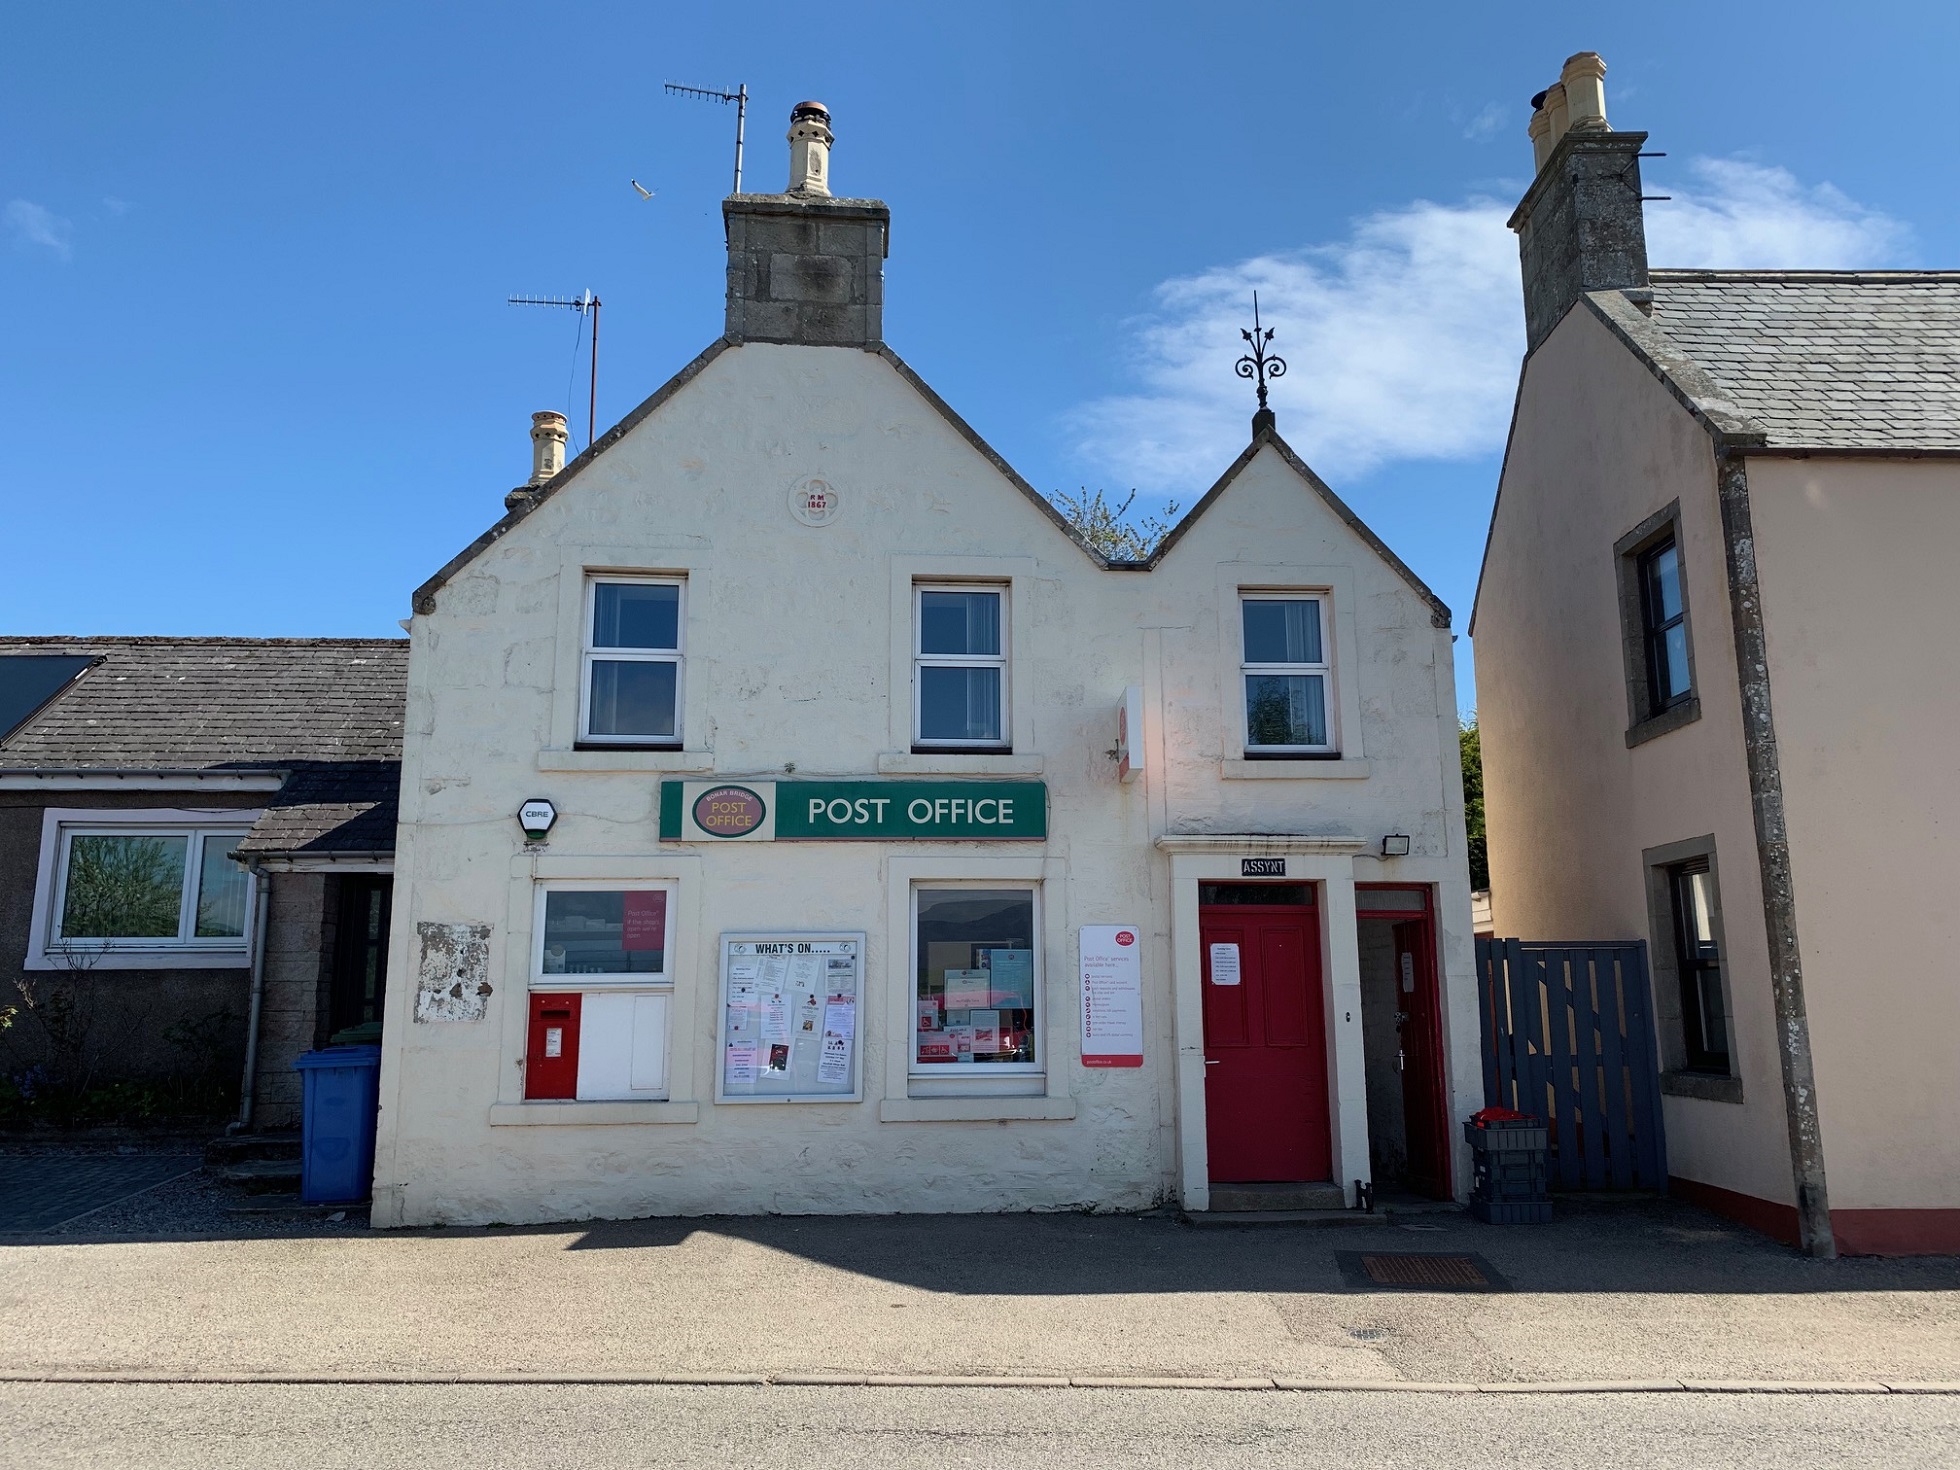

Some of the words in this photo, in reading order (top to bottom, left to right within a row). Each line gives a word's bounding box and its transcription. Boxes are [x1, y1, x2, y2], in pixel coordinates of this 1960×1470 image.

[706, 790, 728, 802] BONAR
[729, 790, 753, 802] BRIDGE
[711, 802, 747, 813] POST
[809, 798, 890, 824] POST
[907, 798, 1014, 824] OFFICE
[525, 810, 549, 818] CBRE
[706, 815, 752, 826] OFFICE
[1243, 860, 1284, 873] ASSYNT
[755, 943, 794, 954] WHAT'S
